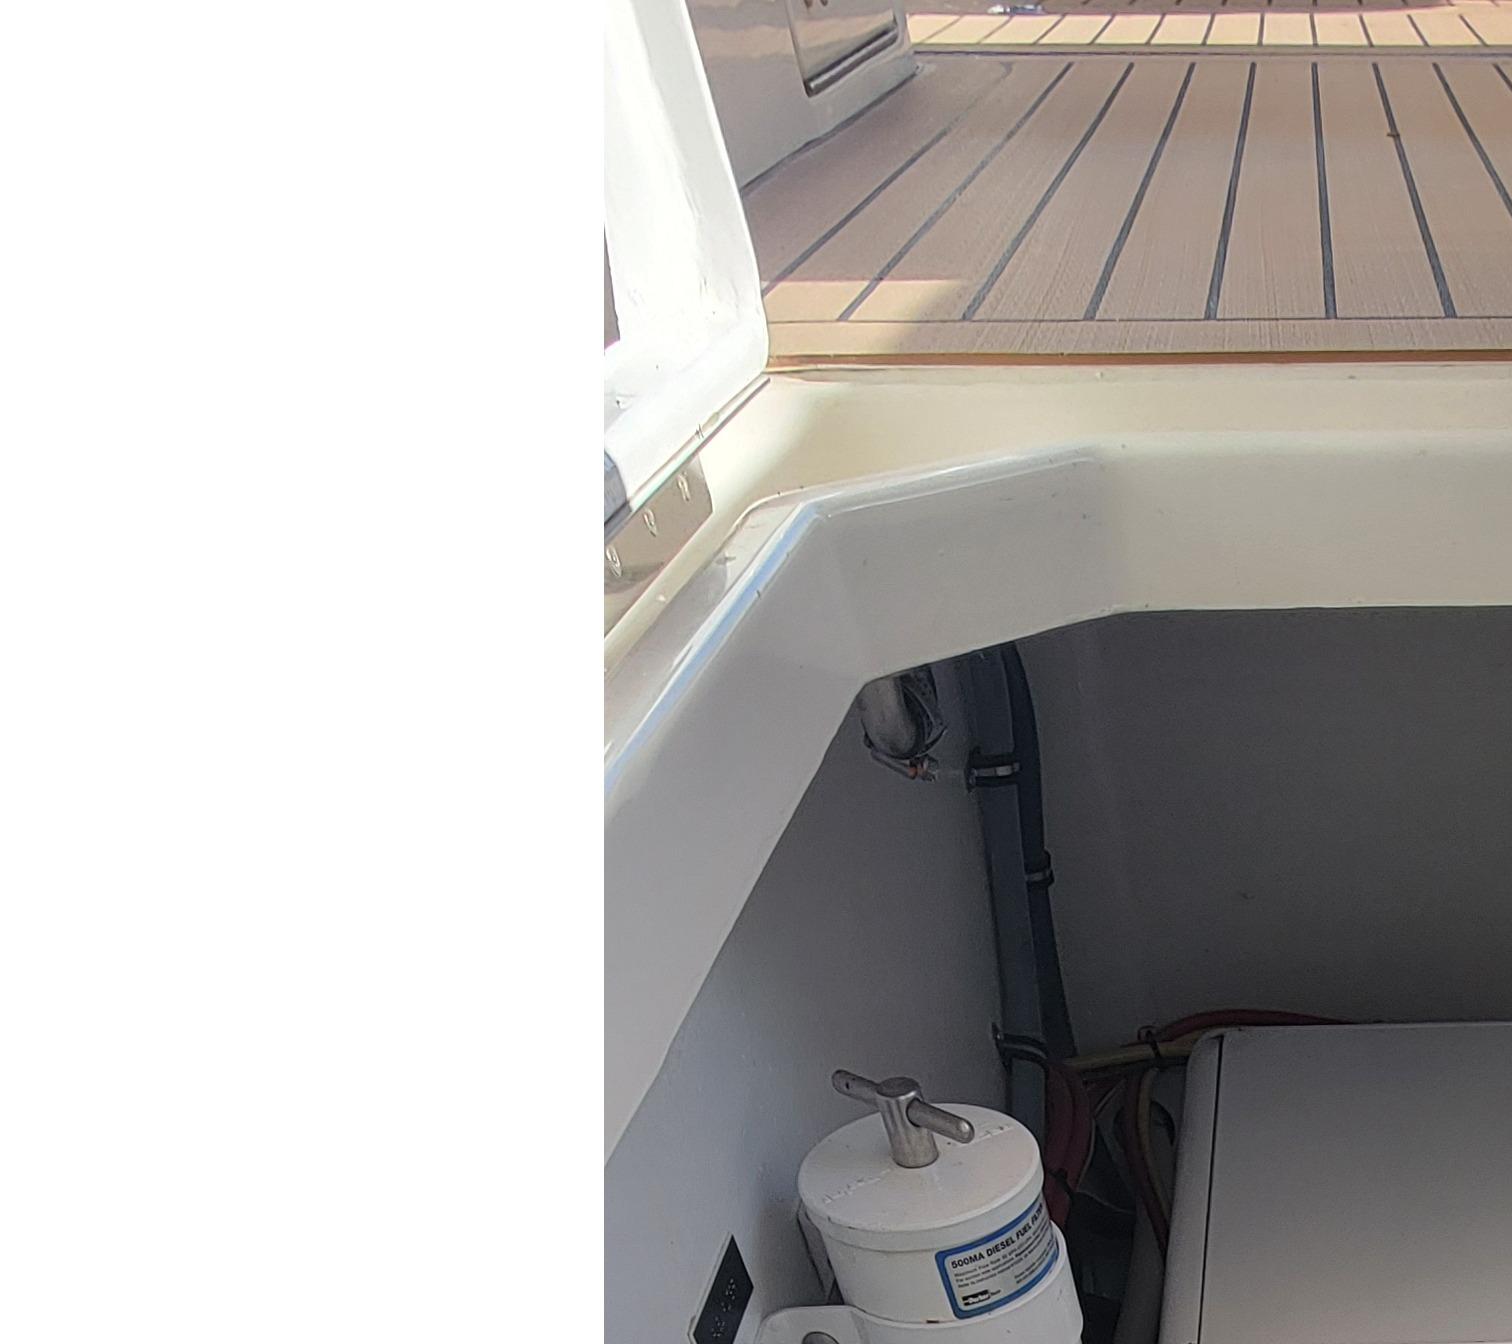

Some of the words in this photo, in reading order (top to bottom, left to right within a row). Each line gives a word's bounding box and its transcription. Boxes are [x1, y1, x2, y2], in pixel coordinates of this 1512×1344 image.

[951, 1252, 985, 1269] 500MA
[986, 1236, 1016, 1257] DIESEL
[1016, 1222, 1033, 1241] FUEL
